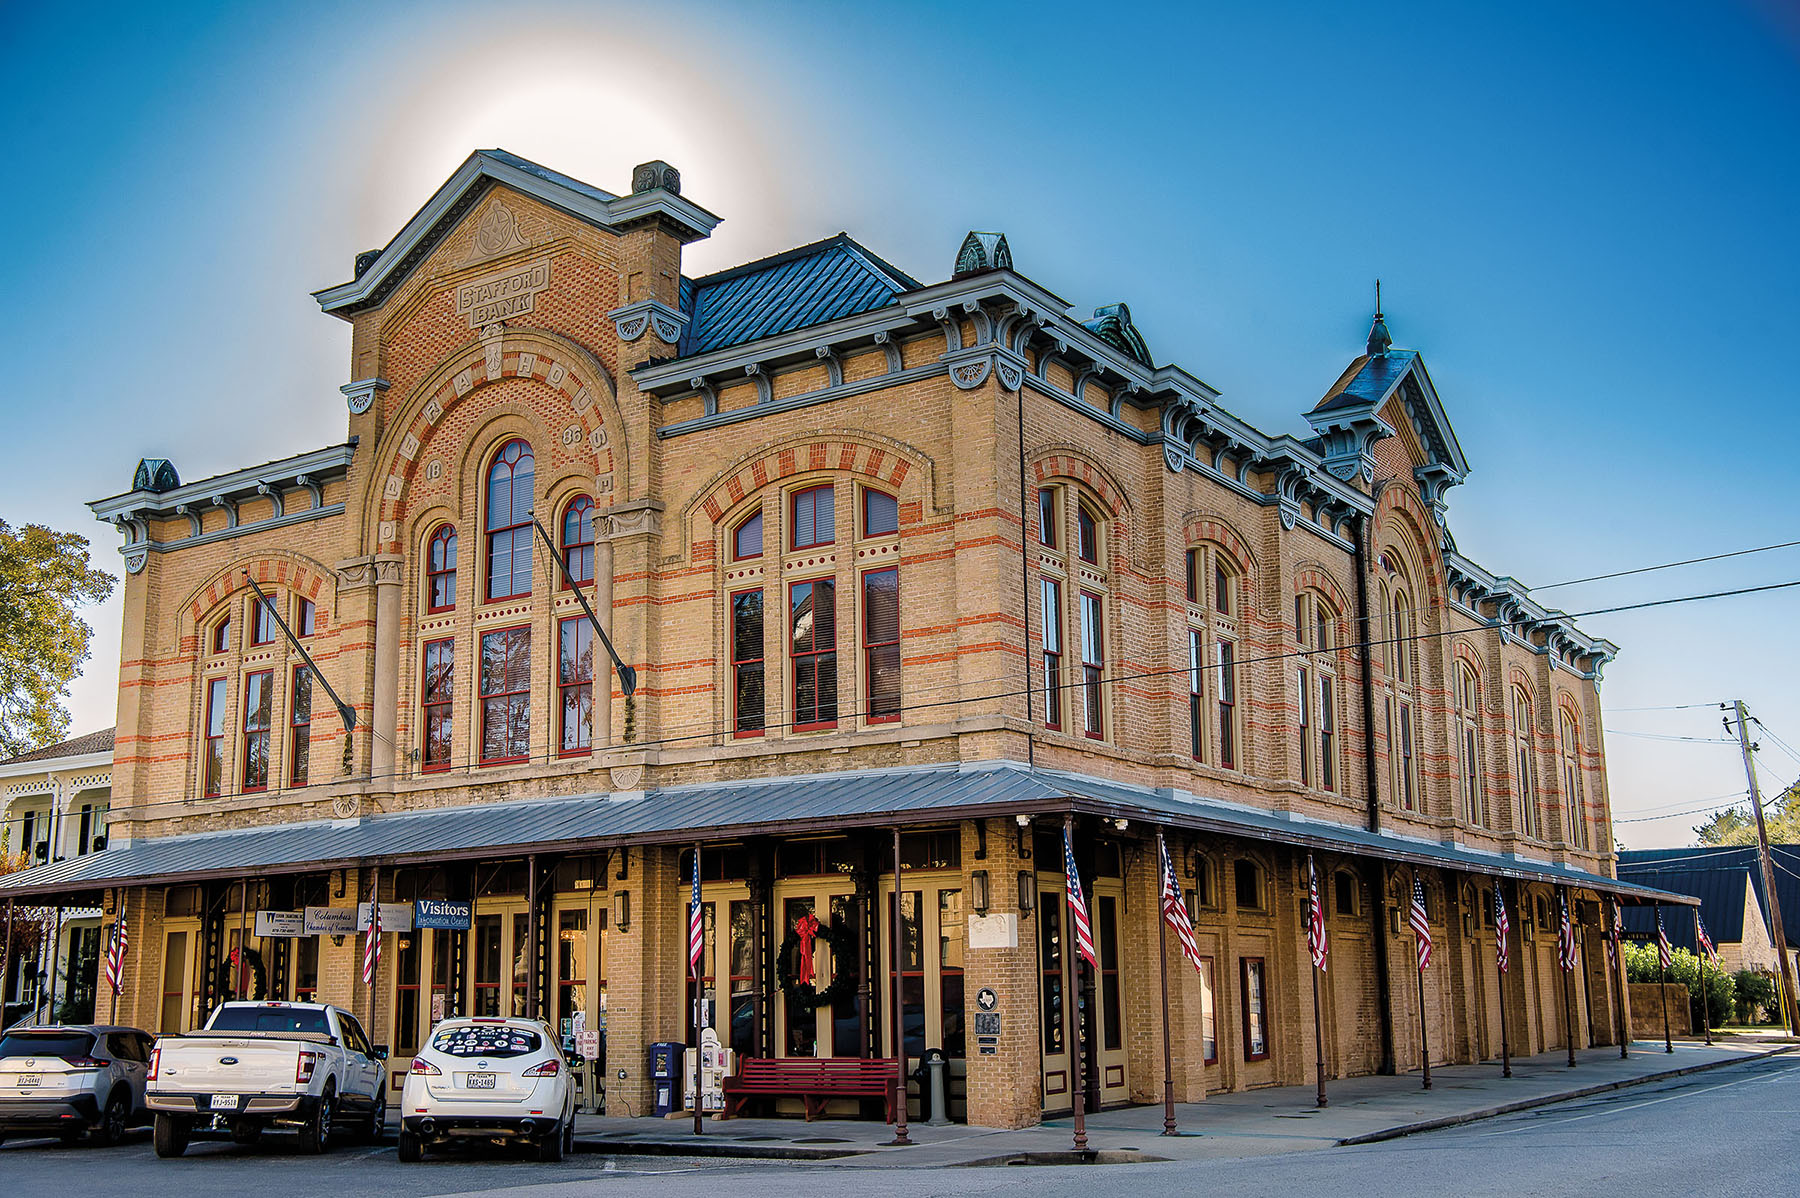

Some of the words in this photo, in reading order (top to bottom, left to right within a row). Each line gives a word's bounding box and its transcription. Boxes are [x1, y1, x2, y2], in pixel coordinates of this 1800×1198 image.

[461, 266, 546, 309] STAFFORD
[478, 294, 532, 324] BANK
[563, 426, 583, 445] 86
[381, 374, 473, 540] OPERA
[517, 357, 613, 493] HOUSE
[426, 460, 443, 479] 18
[313, 909, 352, 920] Columbus
[419, 901, 469, 916] Visitors
[305, 921, 327, 931] Chamber
[327, 922, 335, 933] of
[417, 914, 449, 926] Information
[450, 916, 469, 926] Center
